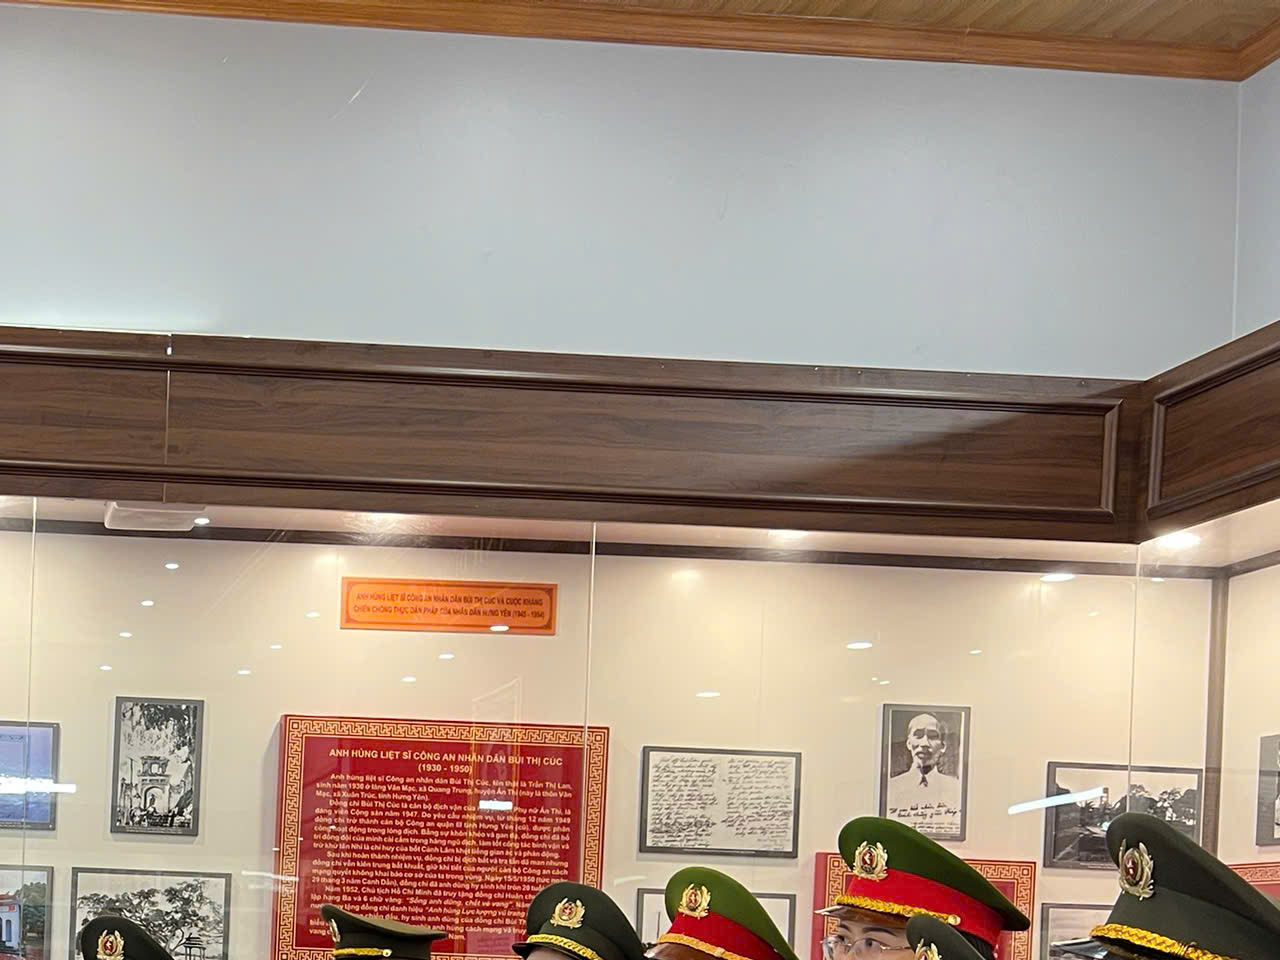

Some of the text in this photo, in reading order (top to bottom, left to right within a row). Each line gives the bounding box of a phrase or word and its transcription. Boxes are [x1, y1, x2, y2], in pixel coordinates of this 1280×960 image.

[329, 747, 562, 766] ANH HÙNG LIỆT SĨ CÔNG AN NHÂN DÂN BÙI THỊ CÚC
[417, 763, 441, 773] (1930
[449, 764, 472, 774] 1950)
